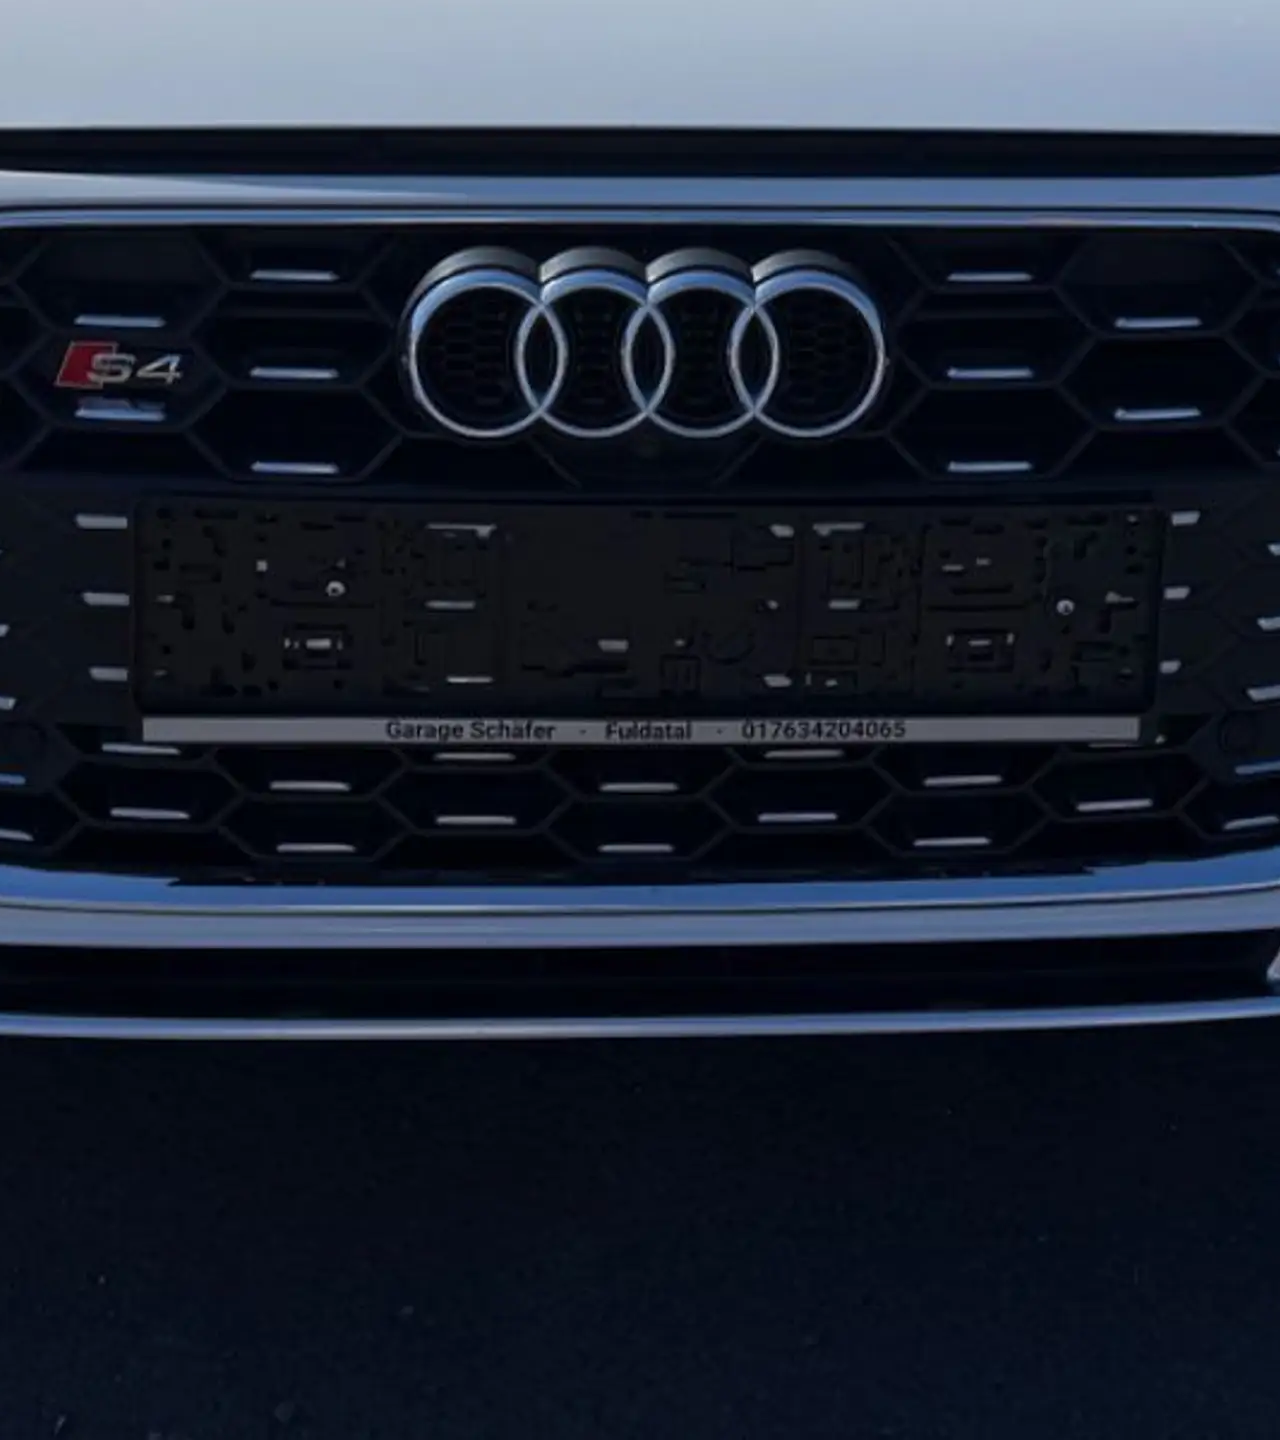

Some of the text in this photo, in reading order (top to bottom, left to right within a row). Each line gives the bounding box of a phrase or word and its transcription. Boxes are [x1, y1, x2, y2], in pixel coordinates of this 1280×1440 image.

[86, 352, 183, 384] S4
[386, 721, 464, 742] Garage
[605, 721, 692, 740] Fuldatal
[742, 721, 906, 740] 017634204065
